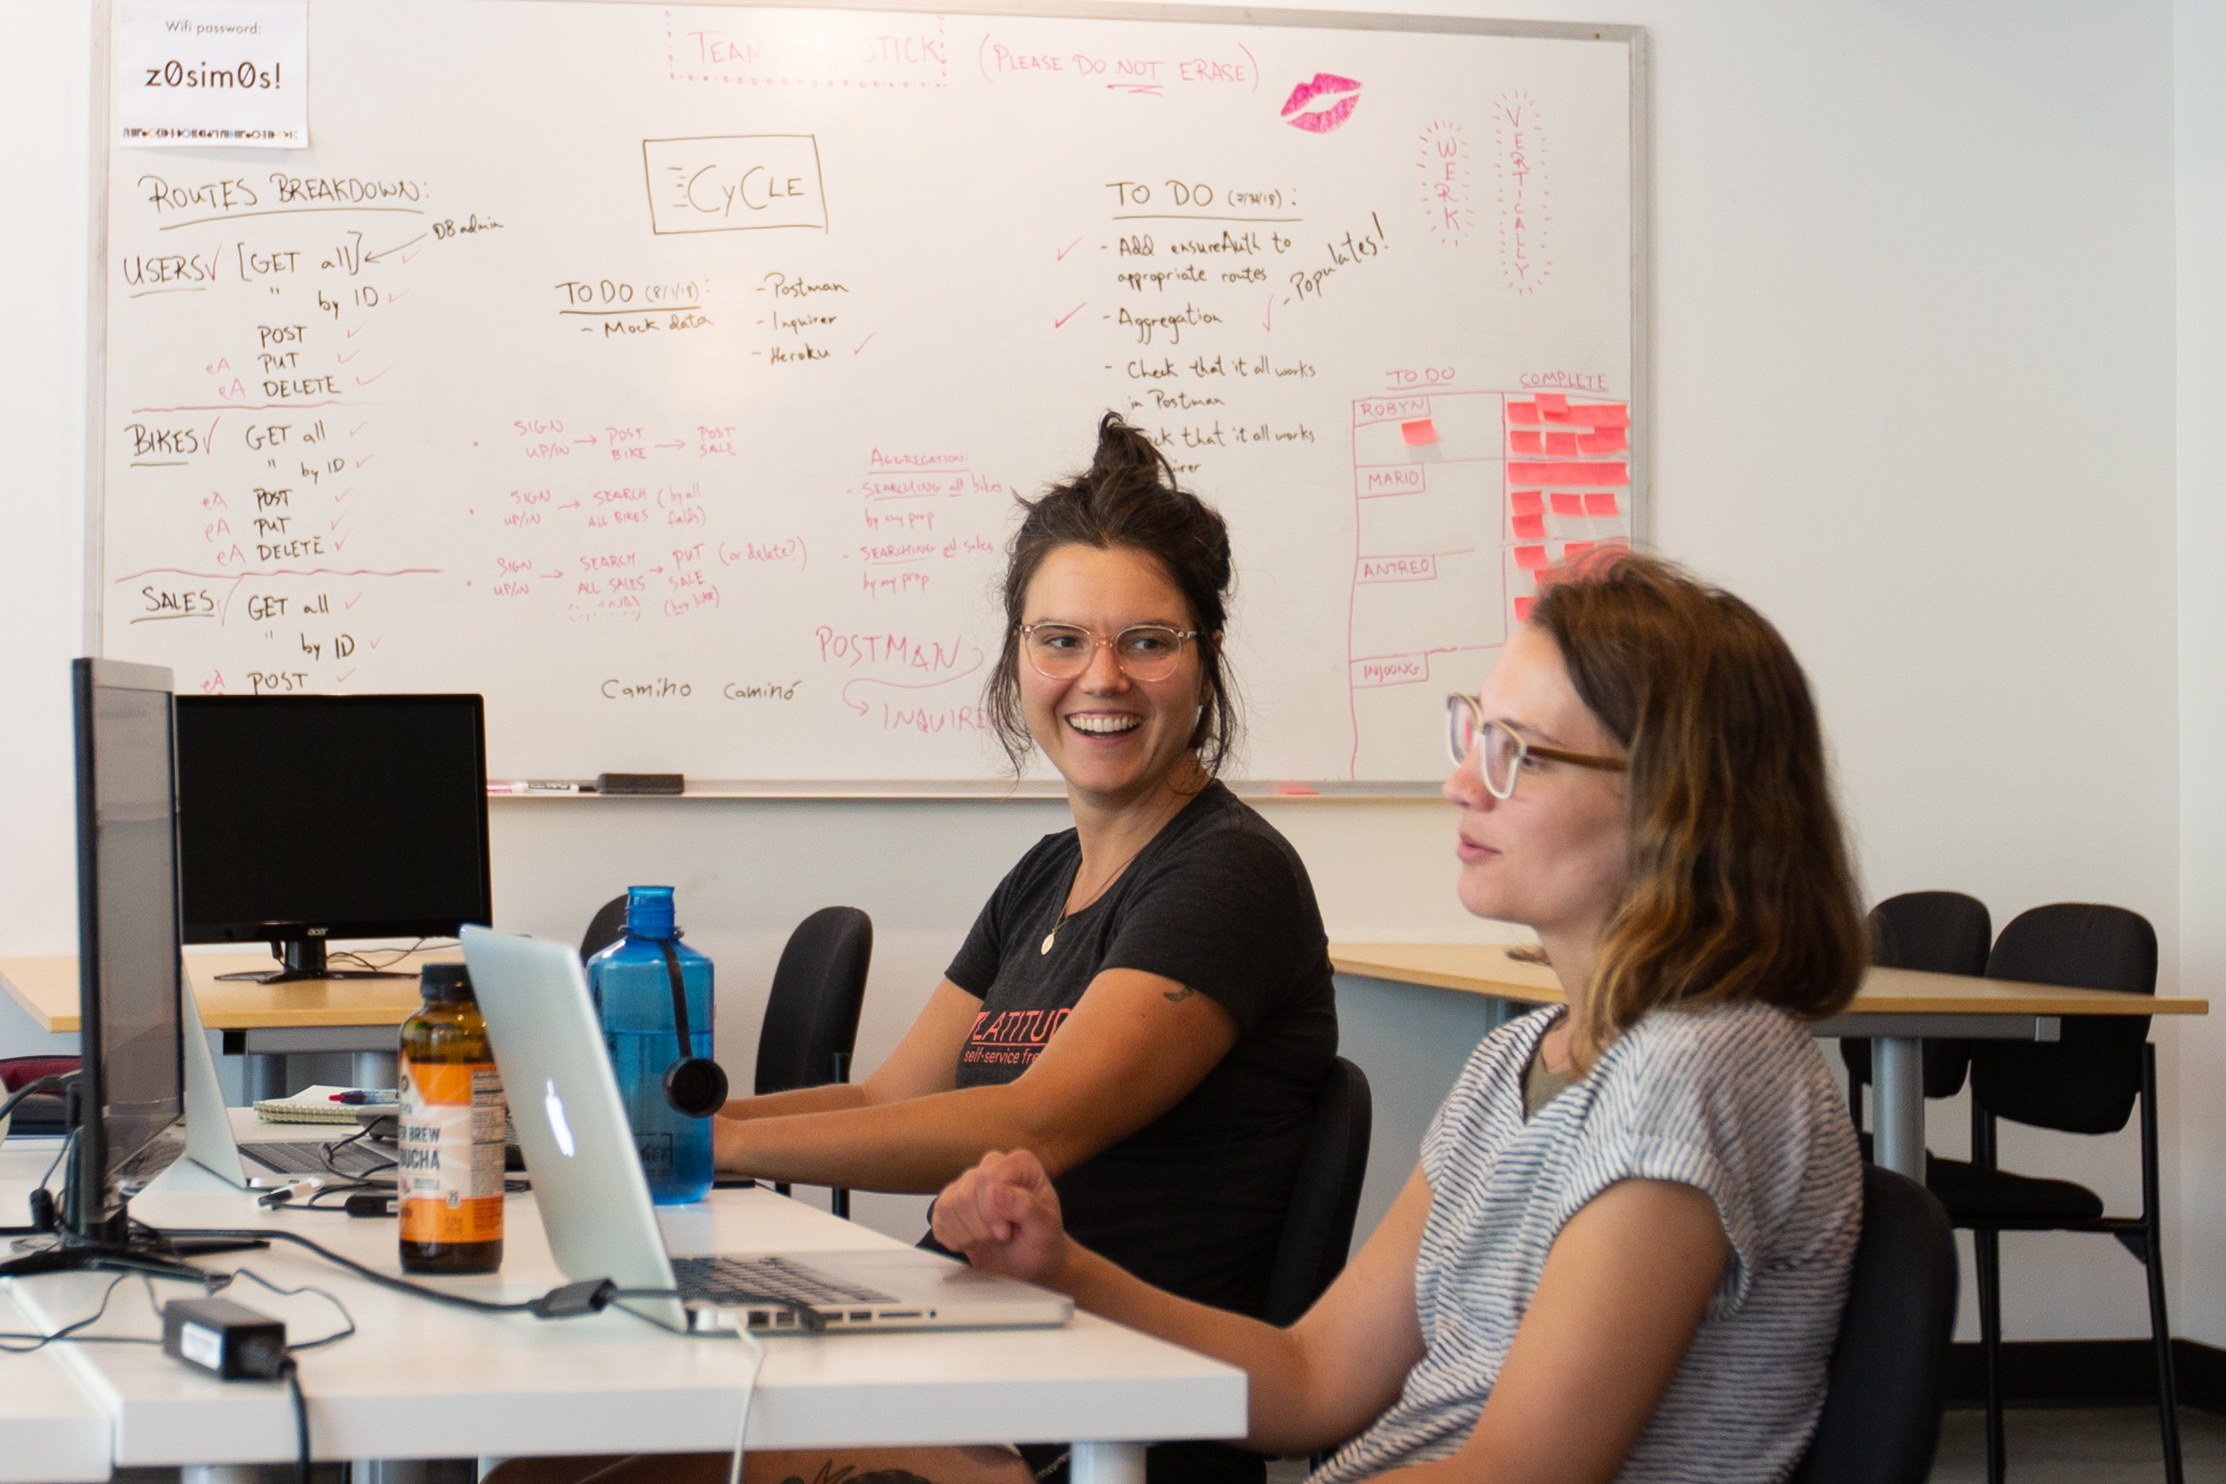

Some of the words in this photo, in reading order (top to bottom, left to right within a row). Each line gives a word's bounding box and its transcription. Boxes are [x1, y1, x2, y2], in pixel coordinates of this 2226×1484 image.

[165, 20, 192, 34] Wifi
[196, 21, 262, 36] password:
[1073, 54, 1106, 75] DO
[1116, 60, 1164, 80] NOT
[1180, 43, 1259, 94] ERASE)
[138, 175, 257, 213] ROUTES
[269, 172, 429, 203] BREAKDOWN:
[1106, 181, 1150, 205] TO
[1166, 180, 1213, 206] DO
[1434, 137, 1461, 231] WERK
[1507, 106, 1531, 279] VERTICALLY
[1120, 234, 1156, 257] Add
[1272, 231, 1291, 253] to
[123, 254, 205, 285] USERS
[1117, 264, 1207, 292] appropriate
[1221, 266, 1267, 283] routes
[764, 271, 850, 299] Postman
[318, 290, 340, 319] by
[604, 319, 660, 338] Mock
[669, 313, 714, 331] data
[1118, 302, 1223, 345] Aggregation
[257, 325, 308, 349] POST
[257, 352, 299, 374] PUT
[770, 342, 831, 366] Heroku
[1128, 358, 1179, 380] Check
[1189, 355, 1226, 379] that
[1232, 359, 1248, 378] it
[1254, 356, 1270, 375] all
[1275, 359, 1316, 379] works
[1386, 370, 1417, 385] TO
[1426, 367, 1456, 381] DO
[262, 375, 341, 398] DELETE
[1519, 372, 1608, 390] COMPLETE
[1147, 389, 1226, 410] Postman
[1360, 400, 1425, 417] ROBYN
[124, 423, 199, 456] BIKES
[245, 425, 292, 451] GET
[303, 419, 326, 444] all
[514, 419, 564, 436] SIGN
[606, 426, 645, 446] POST
[698, 425, 738, 444] POST
[1181, 420, 1227, 448] that
[1232, 427, 1248, 444] it
[1253, 424, 1271, 442] all
[1275, 423, 1315, 444] works
[611, 447, 648, 462] BIKE
[700, 442, 737, 457] SALE
[300, 462, 320, 485] by
[1367, 471, 1419, 490] MARIO
[253, 487, 294, 512] POST
[510, 490, 551, 506] SIGN
[593, 488, 647, 506] SEARCH
[862, 480, 942, 499] SEARCHING
[253, 516, 292, 538] PUT
[613, 510, 649, 525] BIKES
[865, 508, 879, 528] by
[256, 536, 325, 562] DELETE
[672, 542, 706, 571] PUT
[860, 543, 937, 561] SEARCHING
[496, 556, 533, 577] SIGN
[579, 553, 636, 571] SEARCH
[608, 575, 647, 593] SALES
[668, 570, 706, 593] SALE
[863, 572, 877, 599] by
[142, 585, 215, 612] SALES
[247, 595, 290, 621] GET
[303, 593, 330, 615] all
[300, 632, 321, 661] by
[815, 625, 961, 671] POSTMAN
[247, 671, 309, 694] POST
[963, 1046, 1020, 1065] self-service
